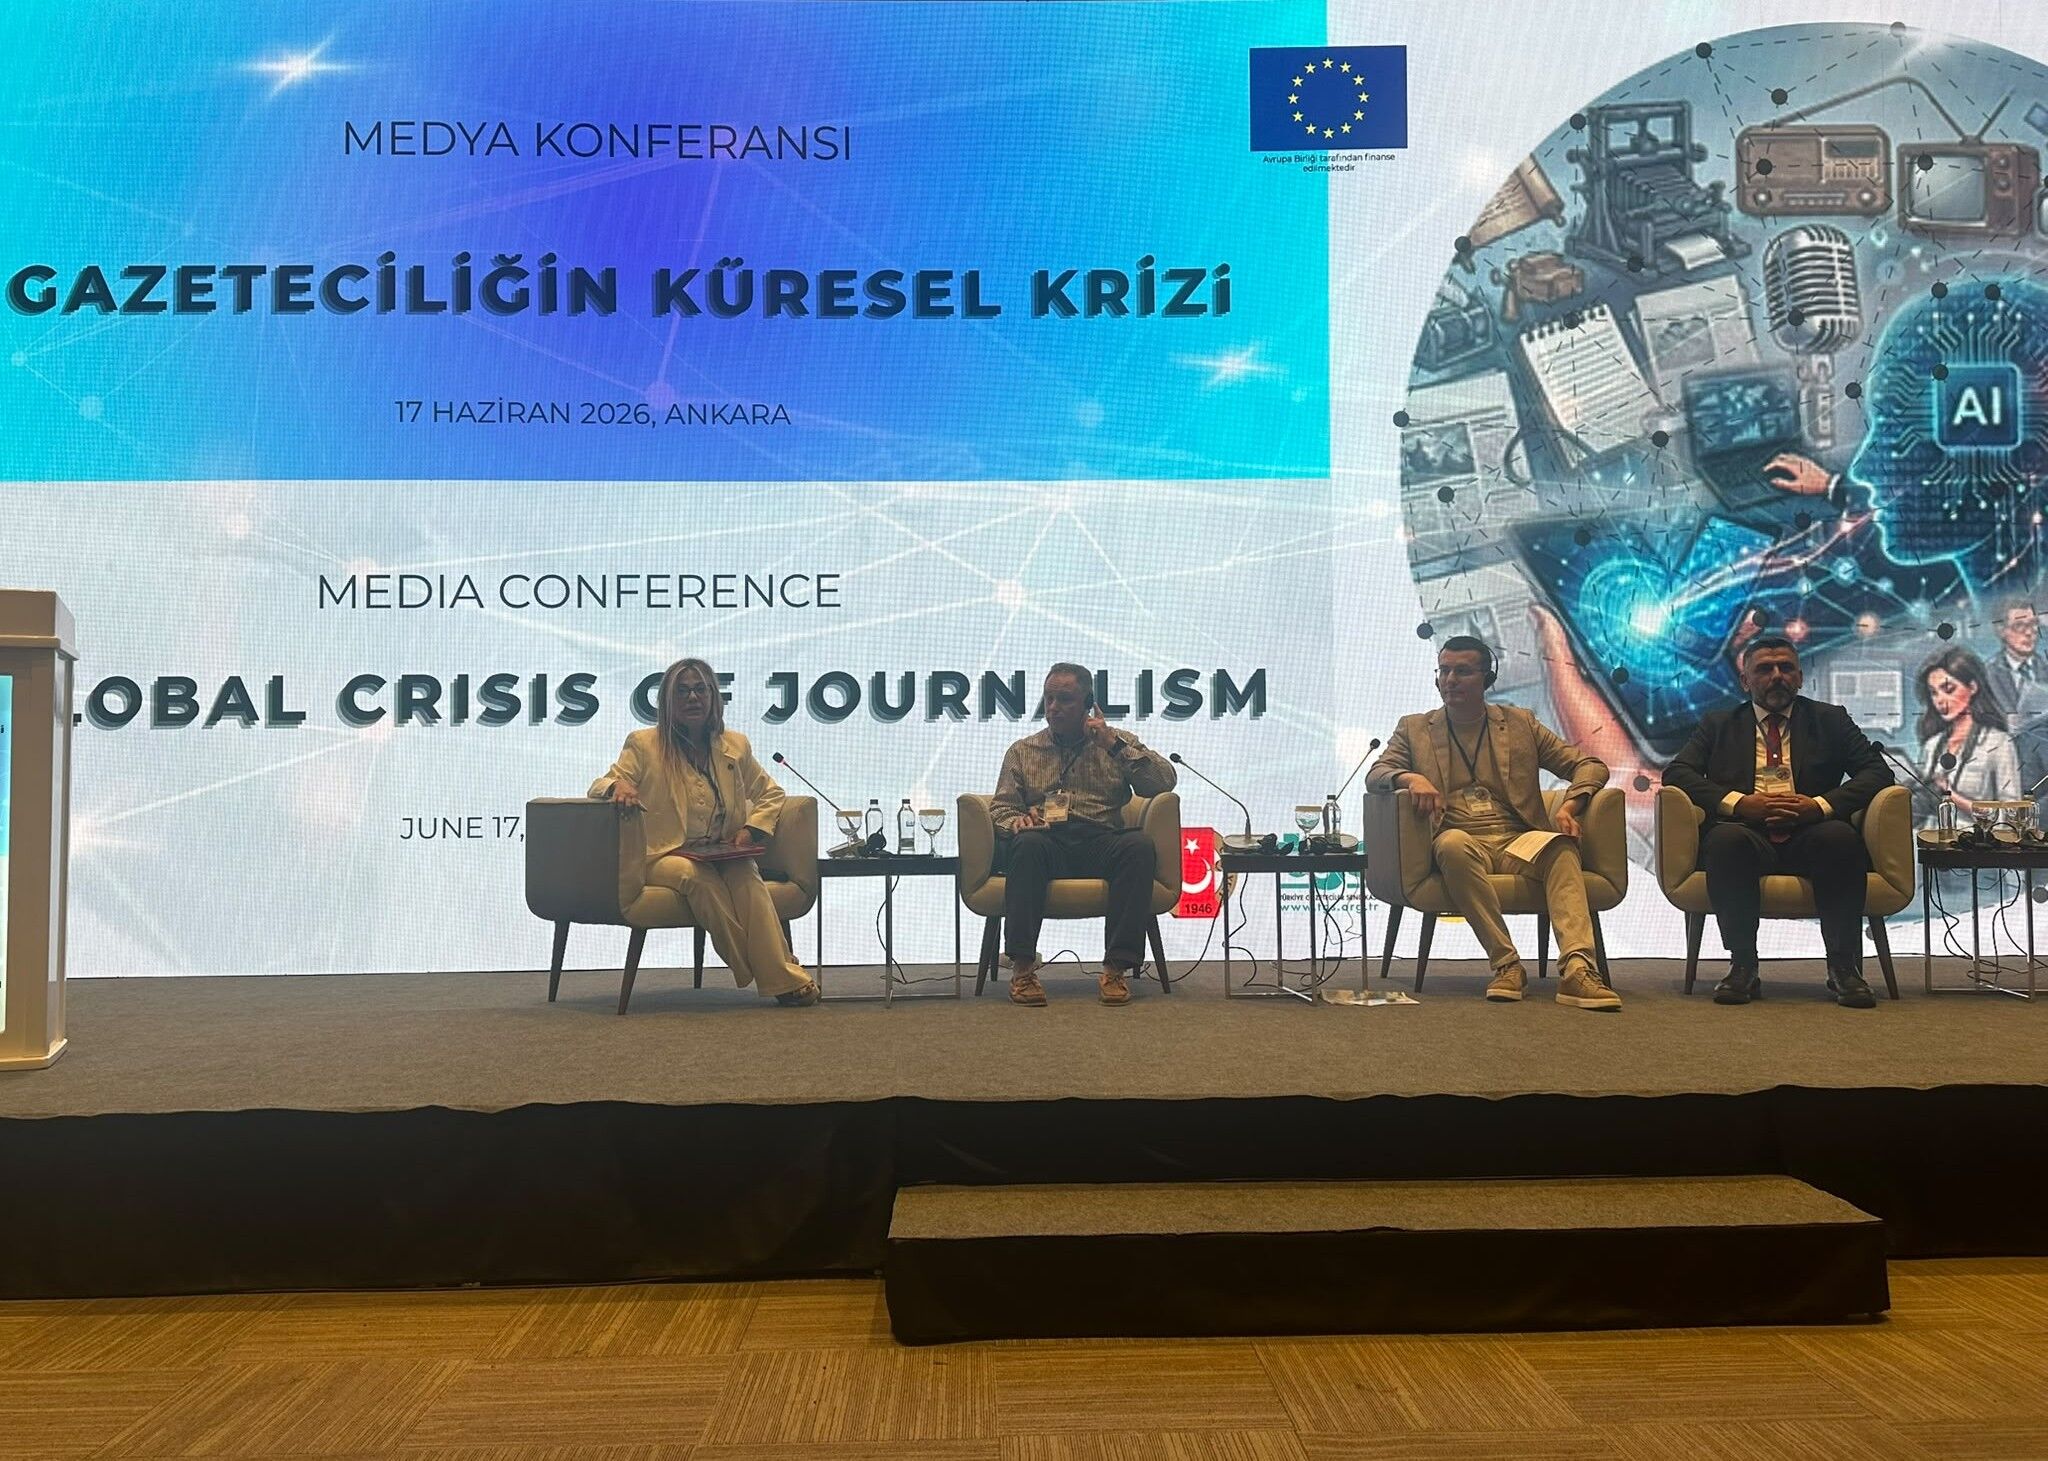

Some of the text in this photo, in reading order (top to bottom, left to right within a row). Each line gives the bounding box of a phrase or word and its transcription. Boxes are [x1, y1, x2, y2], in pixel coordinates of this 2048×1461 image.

[345, 121, 851, 161] MEDYA KONFERANSI
[1263, 155, 1292, 164] Avrupa
[1364, 152, 1396, 161] finanse
[6, 250, 617, 318] GAZETECİLİĞİN
[650, 256, 1002, 319] KÜRESEL
[395, 397, 792, 429] 17 HAZİRAN 2026, ANKARA
[1953, 386, 2001, 426] AI
[319, 573, 841, 609] MEDIA CONFERENCE
[73, 674, 307, 731] OBAL
[337, 672, 600, 728] CRISIS
[761, 667, 1269, 725] JOURNLISM
[400, 816, 525, 843] JUNE 17,
[1184, 903, 1213, 915] 1946
